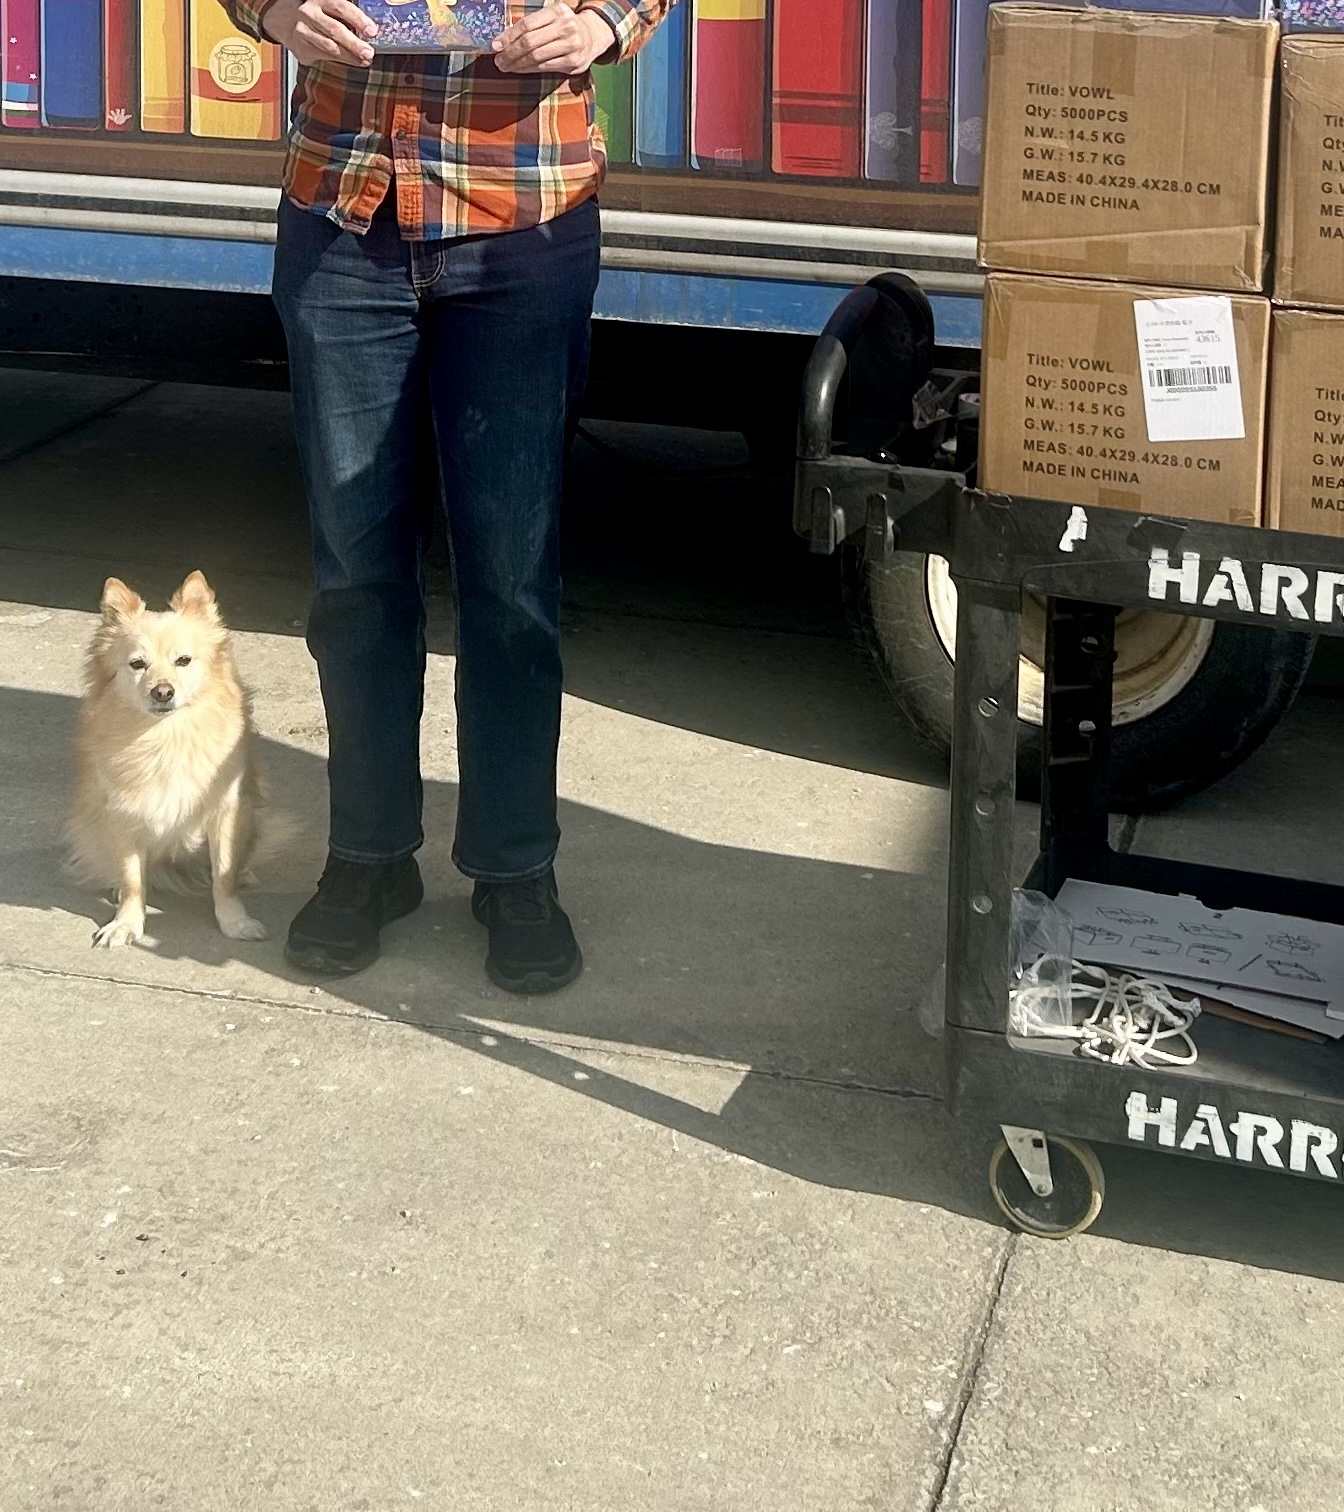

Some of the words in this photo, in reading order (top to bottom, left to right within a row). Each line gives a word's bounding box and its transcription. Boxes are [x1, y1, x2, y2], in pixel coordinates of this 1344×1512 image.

[1026, 82, 1064, 96] Title:
[1069, 85, 1115, 100] VOWL
[1025, 104, 1056, 120] Qty:
[1061, 107, 1128, 122] 5000PCS
[1068, 129, 1098, 142] 14.5
[1103, 132, 1125, 144] KG
[1068, 151, 1098, 163] 15.7
[1103, 154, 1125, 166] KG
[1023, 169, 1072, 183] MEAS:
[1076, 174, 1192, 193] 40.4X29.4X28.0
[1197, 183, 1221, 195] CM
[1022, 190, 1066, 204] MADE
[1071, 194, 1085, 206] IN
[1090, 196, 1140, 210] CHINA
[1027, 353, 1064, 368] Title:
[1069, 357, 1115, 373] VOWL
[1026, 375, 1055, 390] Qty:
[1061, 379, 1128, 396] 5000PCS
[1068, 401, 1099, 415] 14.5
[1103, 404, 1125, 417] KG
[1068, 423, 1098, 435] 15.7
[1103, 426, 1125, 439] KG
[1023, 439, 1072, 456] MEAS:
[1076, 445, 1192, 468] 40.4X29.4X28.0
[1196, 458, 1221, 471] CM
[1023, 461, 1066, 476] MADE
[1071, 465, 1085, 478] IN
[1090, 468, 1140, 484] CHINA
